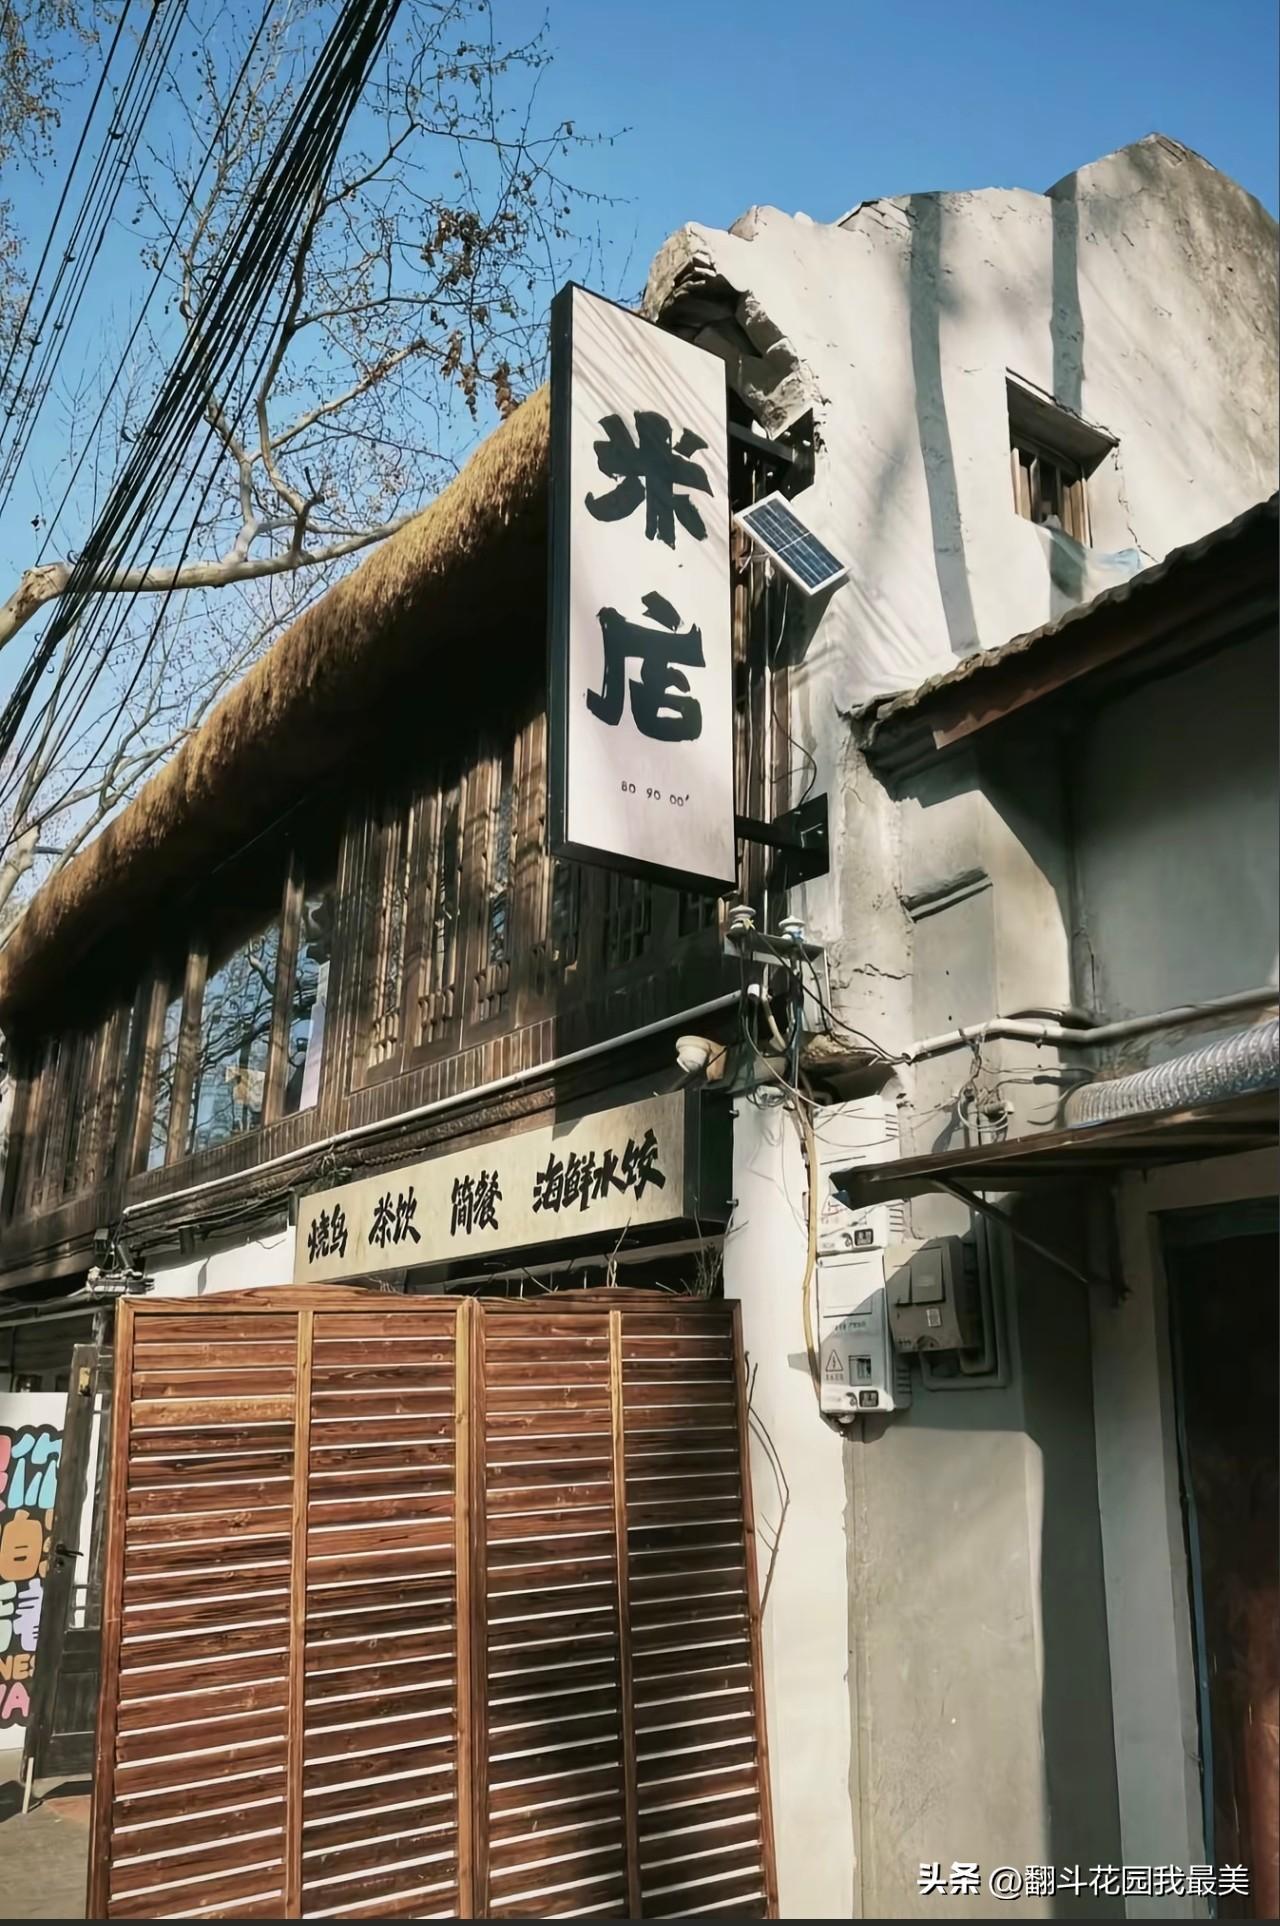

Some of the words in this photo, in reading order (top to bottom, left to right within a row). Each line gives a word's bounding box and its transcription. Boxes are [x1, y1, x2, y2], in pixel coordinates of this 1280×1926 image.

[584, 410, 714, 743] 米店
[621, 780, 636, 794] 80
[646, 787, 661, 801] 90
[307, 1203, 349, 1264] 烧鸟
[368, 1186, 422, 1249] 茶饮
[450, 1170, 503, 1237] 简餐
[532, 1127, 667, 1213] 海鲜水饺
